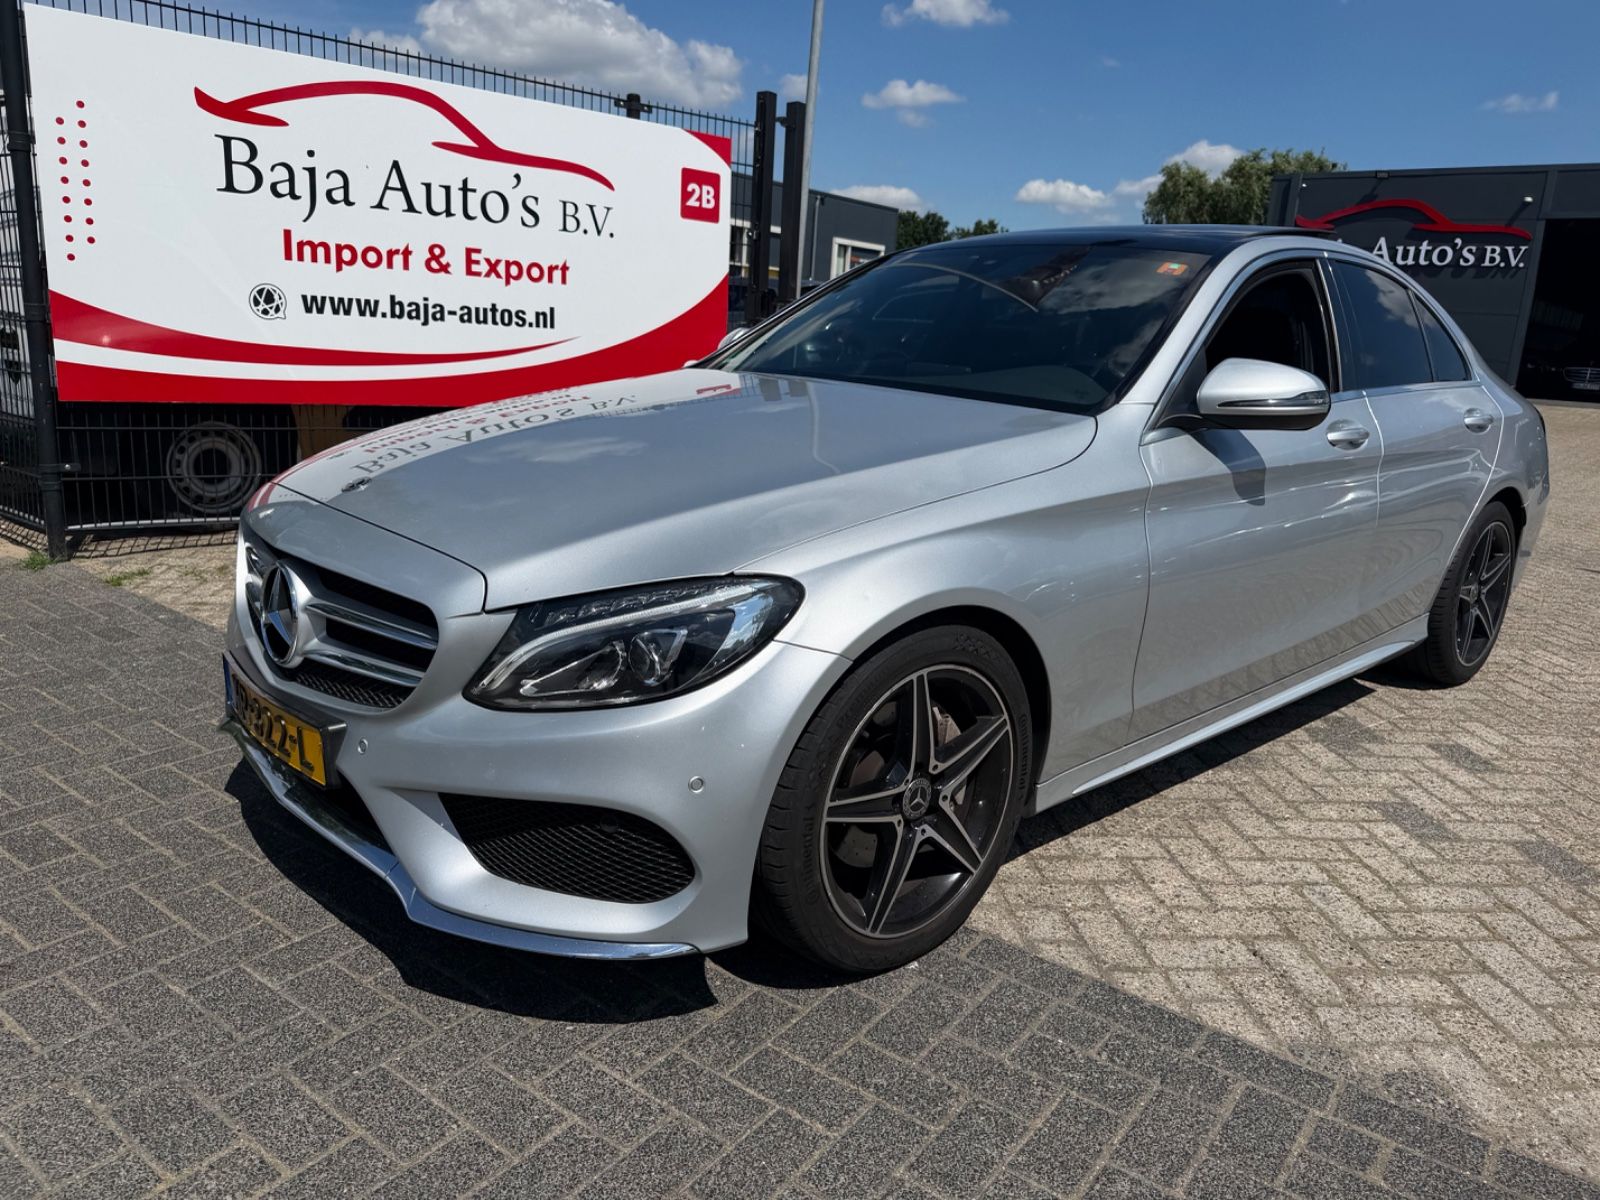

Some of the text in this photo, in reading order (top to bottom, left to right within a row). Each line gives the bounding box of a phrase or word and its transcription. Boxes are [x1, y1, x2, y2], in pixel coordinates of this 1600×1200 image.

[214, 133, 614, 239] Baja Auto's B.V.
[686, 183, 715, 209] 2B
[283, 228, 570, 287] Import & Export
[1373, 236, 1529, 268] Auto's B.V.
[300, 294, 555, 330] www.baja-autos.nl
